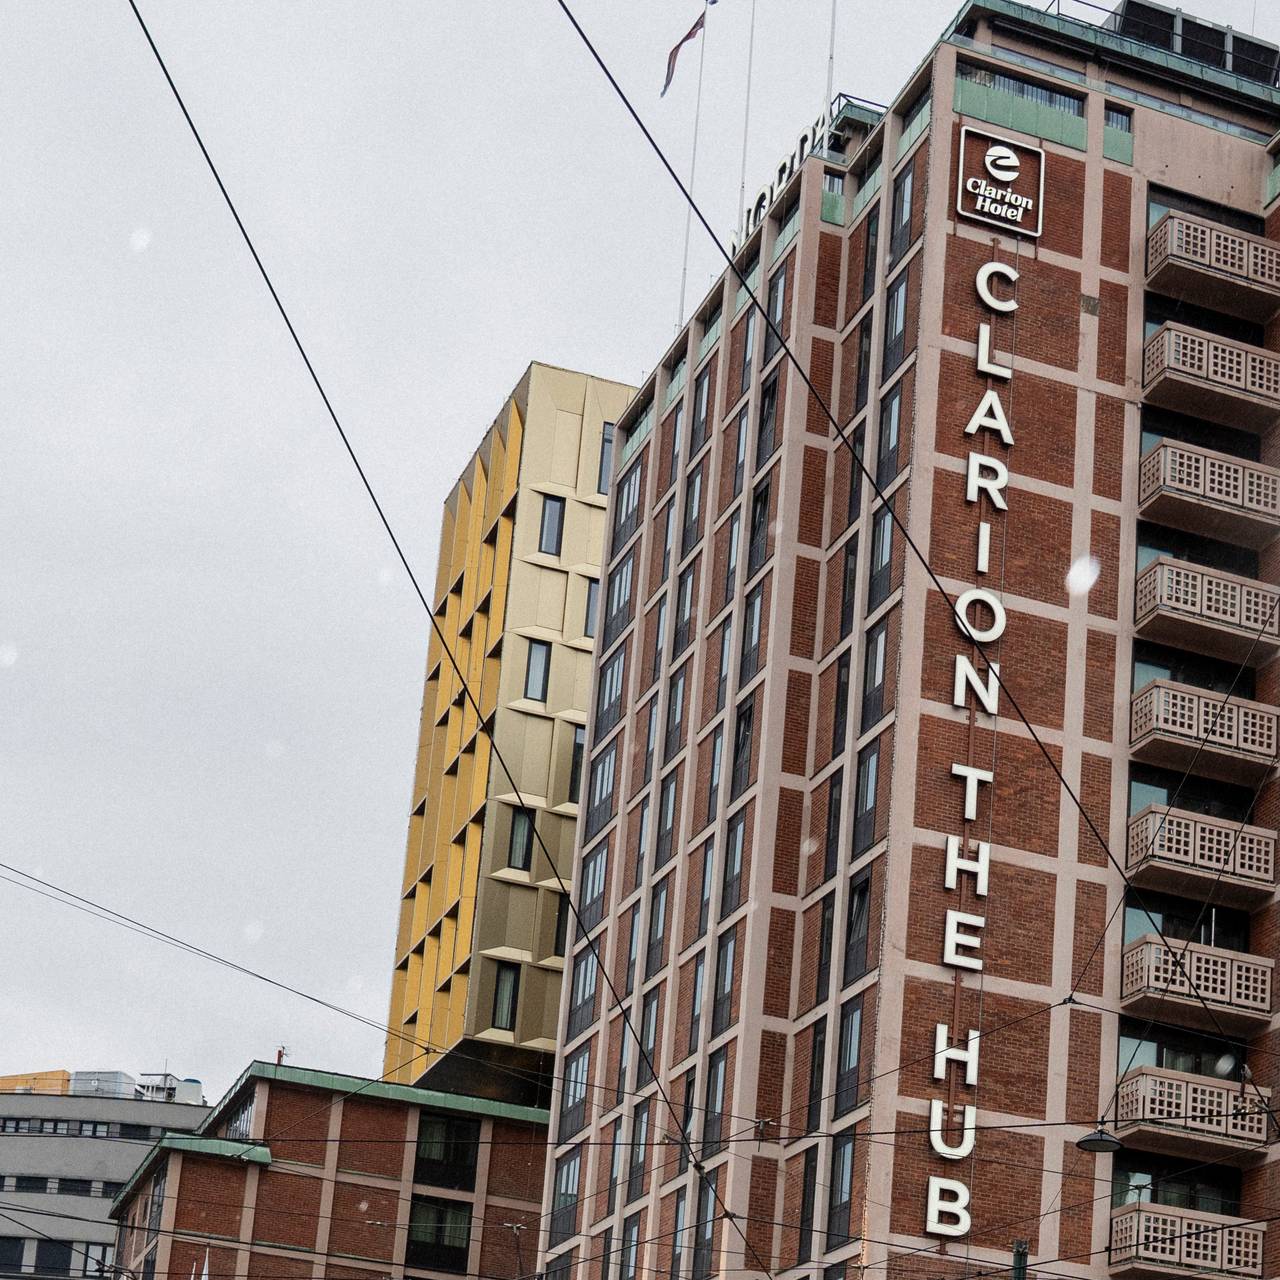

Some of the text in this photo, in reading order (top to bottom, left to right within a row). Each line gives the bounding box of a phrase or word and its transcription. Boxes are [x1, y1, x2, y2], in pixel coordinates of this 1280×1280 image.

[966, 177, 1033, 211] Clarion
[975, 195, 1024, 223] Hotel
[926, 261, 1020, 1237] CLARION THE HUB
